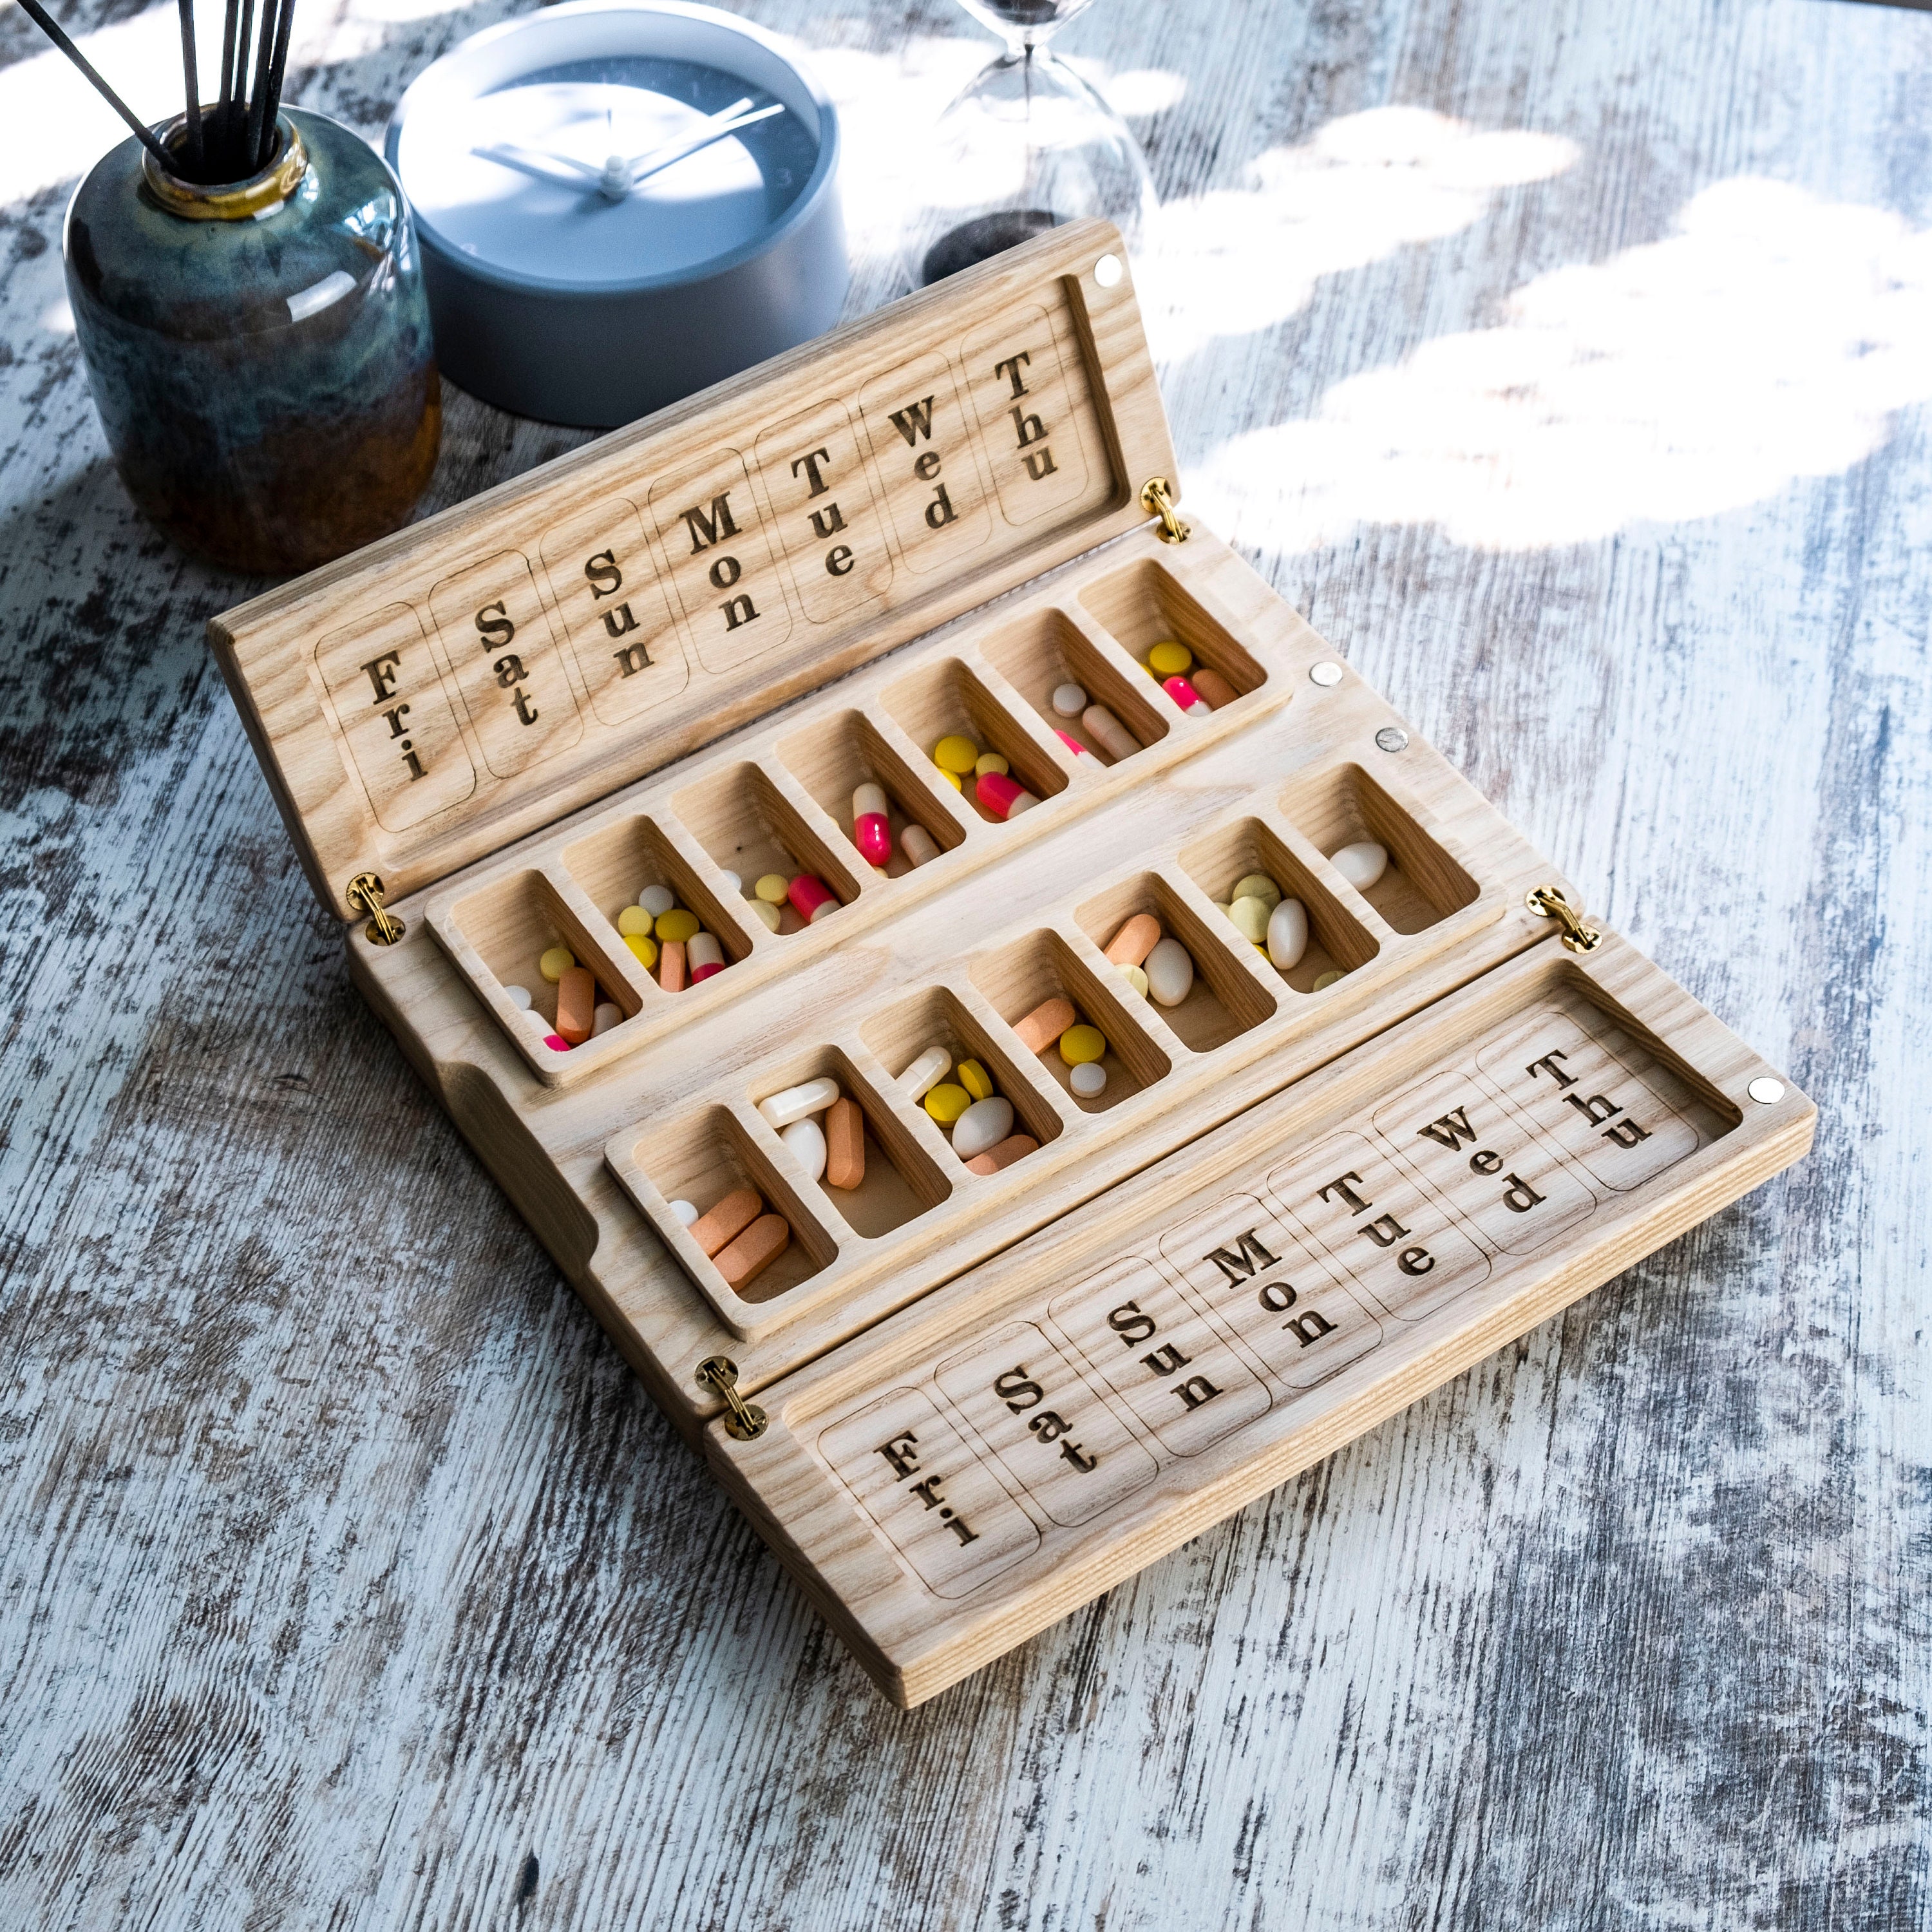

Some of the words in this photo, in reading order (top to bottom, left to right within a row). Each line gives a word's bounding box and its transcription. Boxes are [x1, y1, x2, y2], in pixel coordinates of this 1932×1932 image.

[887, 395, 959, 531] Wed
[994, 351, 1058, 481] Thu
[678, 491, 761, 632] Mon
[791, 448, 855, 577] Tue
[475, 600, 539, 726] Sat
[584, 549, 655, 678] Sun
[359, 649, 429, 782] Fri
[1416, 1105, 1547, 1213] Wed
[1526, 1049, 1653, 1150] Thu
[1316, 1171, 1436, 1277] Tue
[1202, 1227, 1340, 1349] Mon
[1107, 1300, 1226, 1414] Sun
[993, 1365, 1099, 1474] Sat
[873, 1430, 980, 1548] Fri
